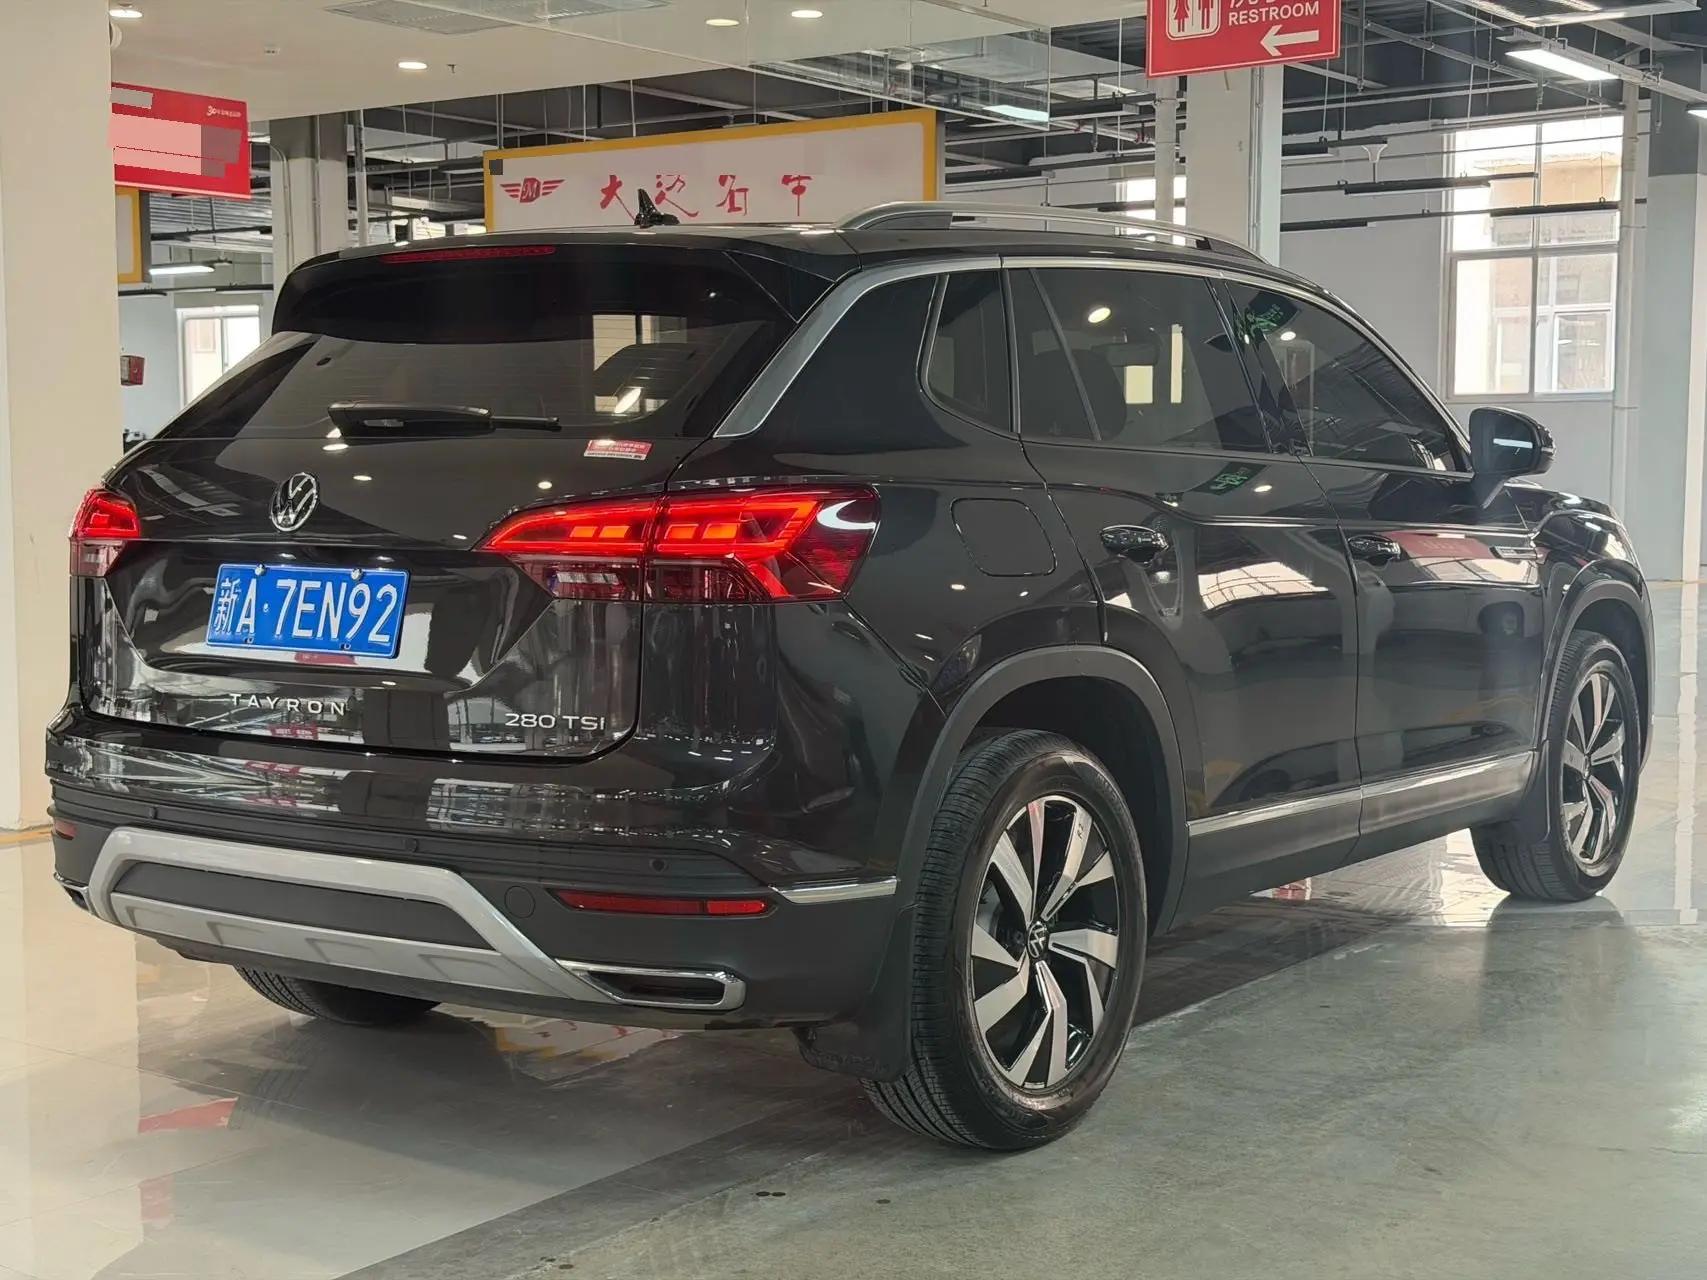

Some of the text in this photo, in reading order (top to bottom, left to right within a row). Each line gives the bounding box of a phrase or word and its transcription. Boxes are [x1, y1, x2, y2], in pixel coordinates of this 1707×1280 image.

[1228, 1, 1320, 26] RESTROOM
[229, 693, 347, 716] TAYRON
[504, 713, 606, 731] 280 TSI
